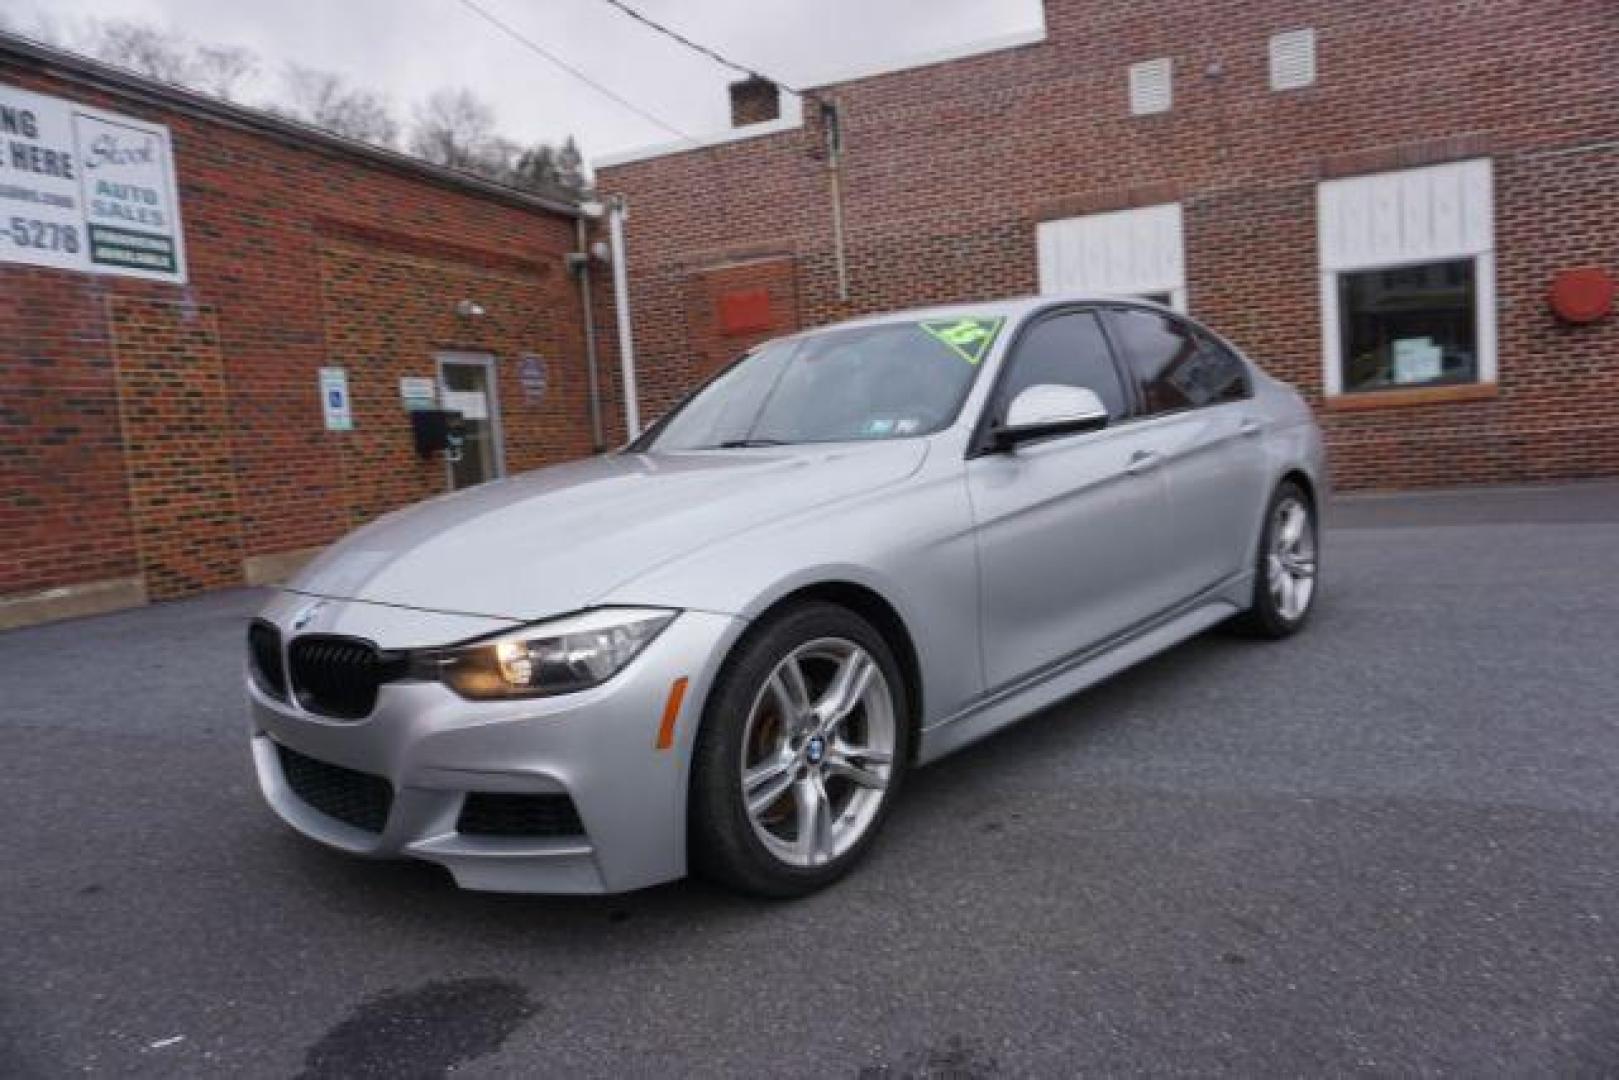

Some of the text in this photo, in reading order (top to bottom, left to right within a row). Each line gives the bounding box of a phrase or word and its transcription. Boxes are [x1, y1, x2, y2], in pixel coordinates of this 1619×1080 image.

[10, 141, 73, 180] HERE
[95, 179, 158, 206] AUTO
[92, 199, 164, 226] SALES
